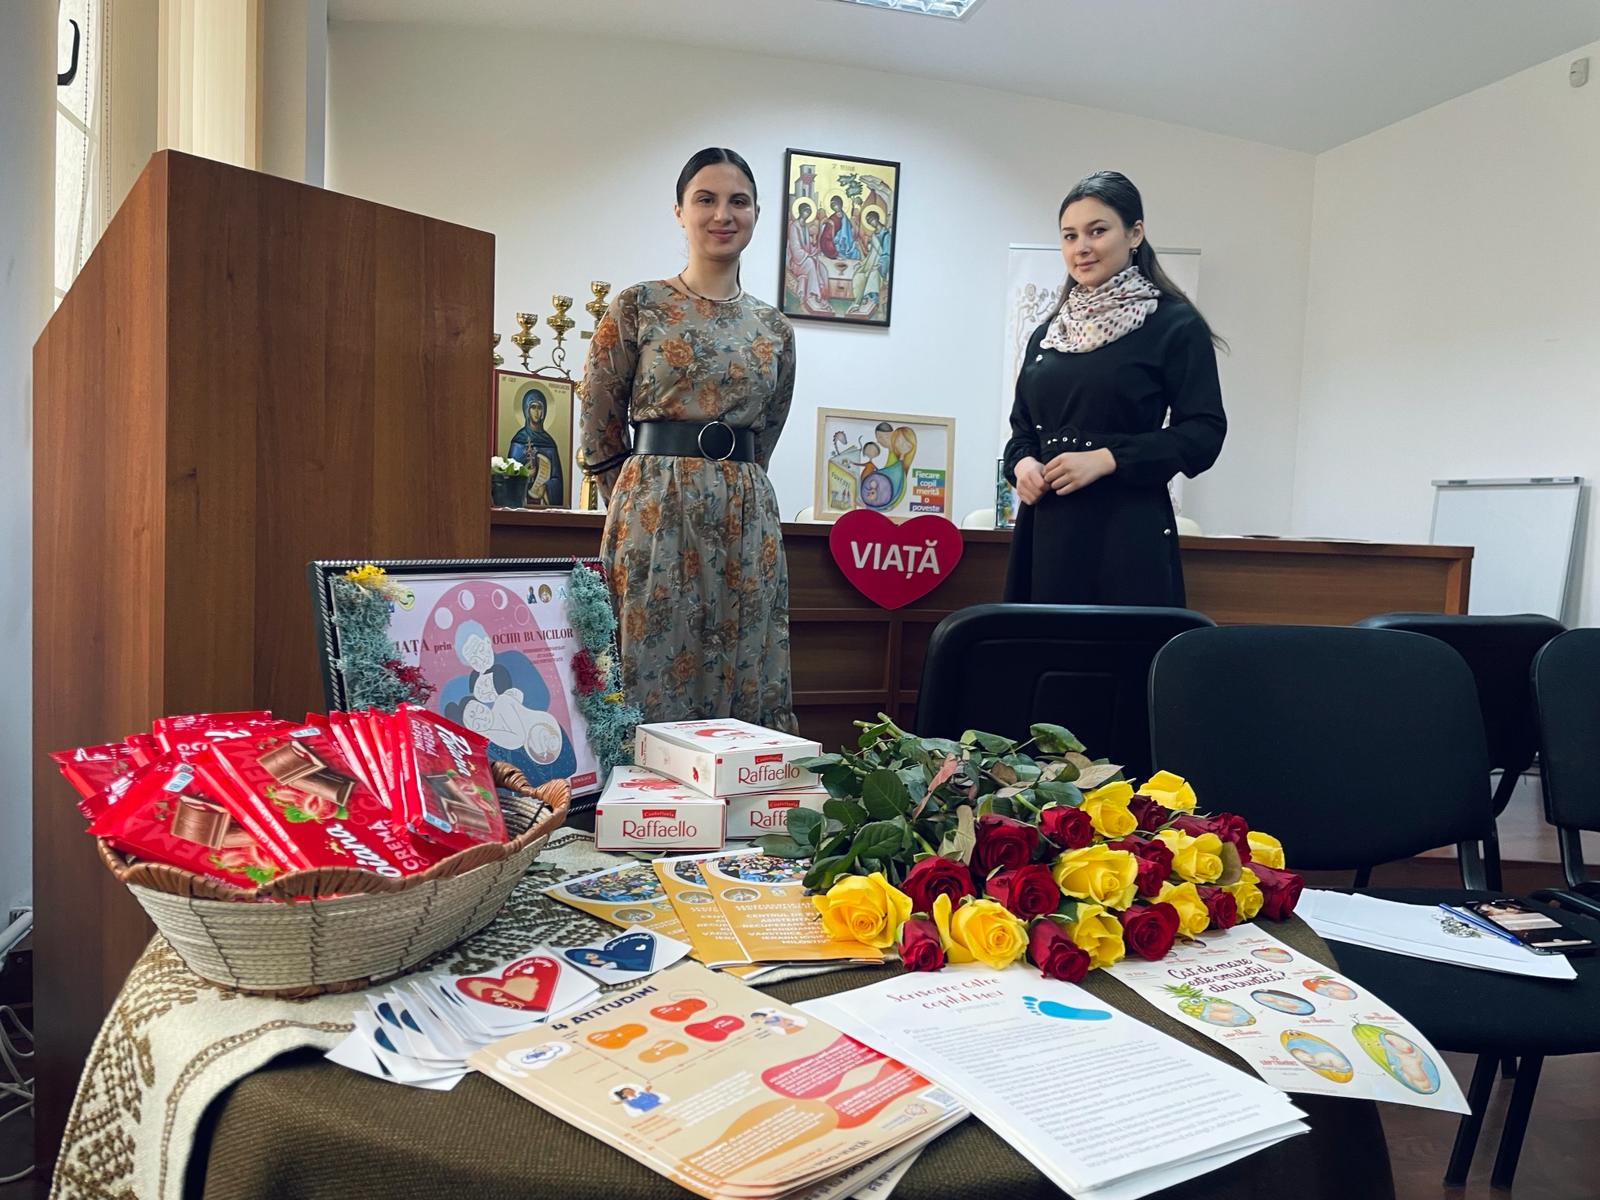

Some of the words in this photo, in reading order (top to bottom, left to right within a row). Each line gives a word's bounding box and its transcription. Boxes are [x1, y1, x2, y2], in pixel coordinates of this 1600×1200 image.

[914, 470, 941, 480] Fiecare
[919, 479, 938, 489] copil
[911, 504, 941, 513] poveste
[923, 496, 930, 504] o
[850, 539, 941, 580] VIAȚĂ
[433, 641, 453, 654] prin
[523, 628, 574, 642] BUNICILOR
[738, 765, 800, 785] Raffaello
[622, 819, 698, 840] Raffaello
[326, 823, 402, 878] oiana
[1198, 965, 1217, 974] de
[1216, 958, 1252, 969] mare
[1188, 976, 1215, 986] este
[1209, 982, 1236, 993] din
[886, 983, 960, 1002] Scrisoare
[551, 1022, 569, 1031] 4
[571, 984, 659, 1025] ATITUDINI
